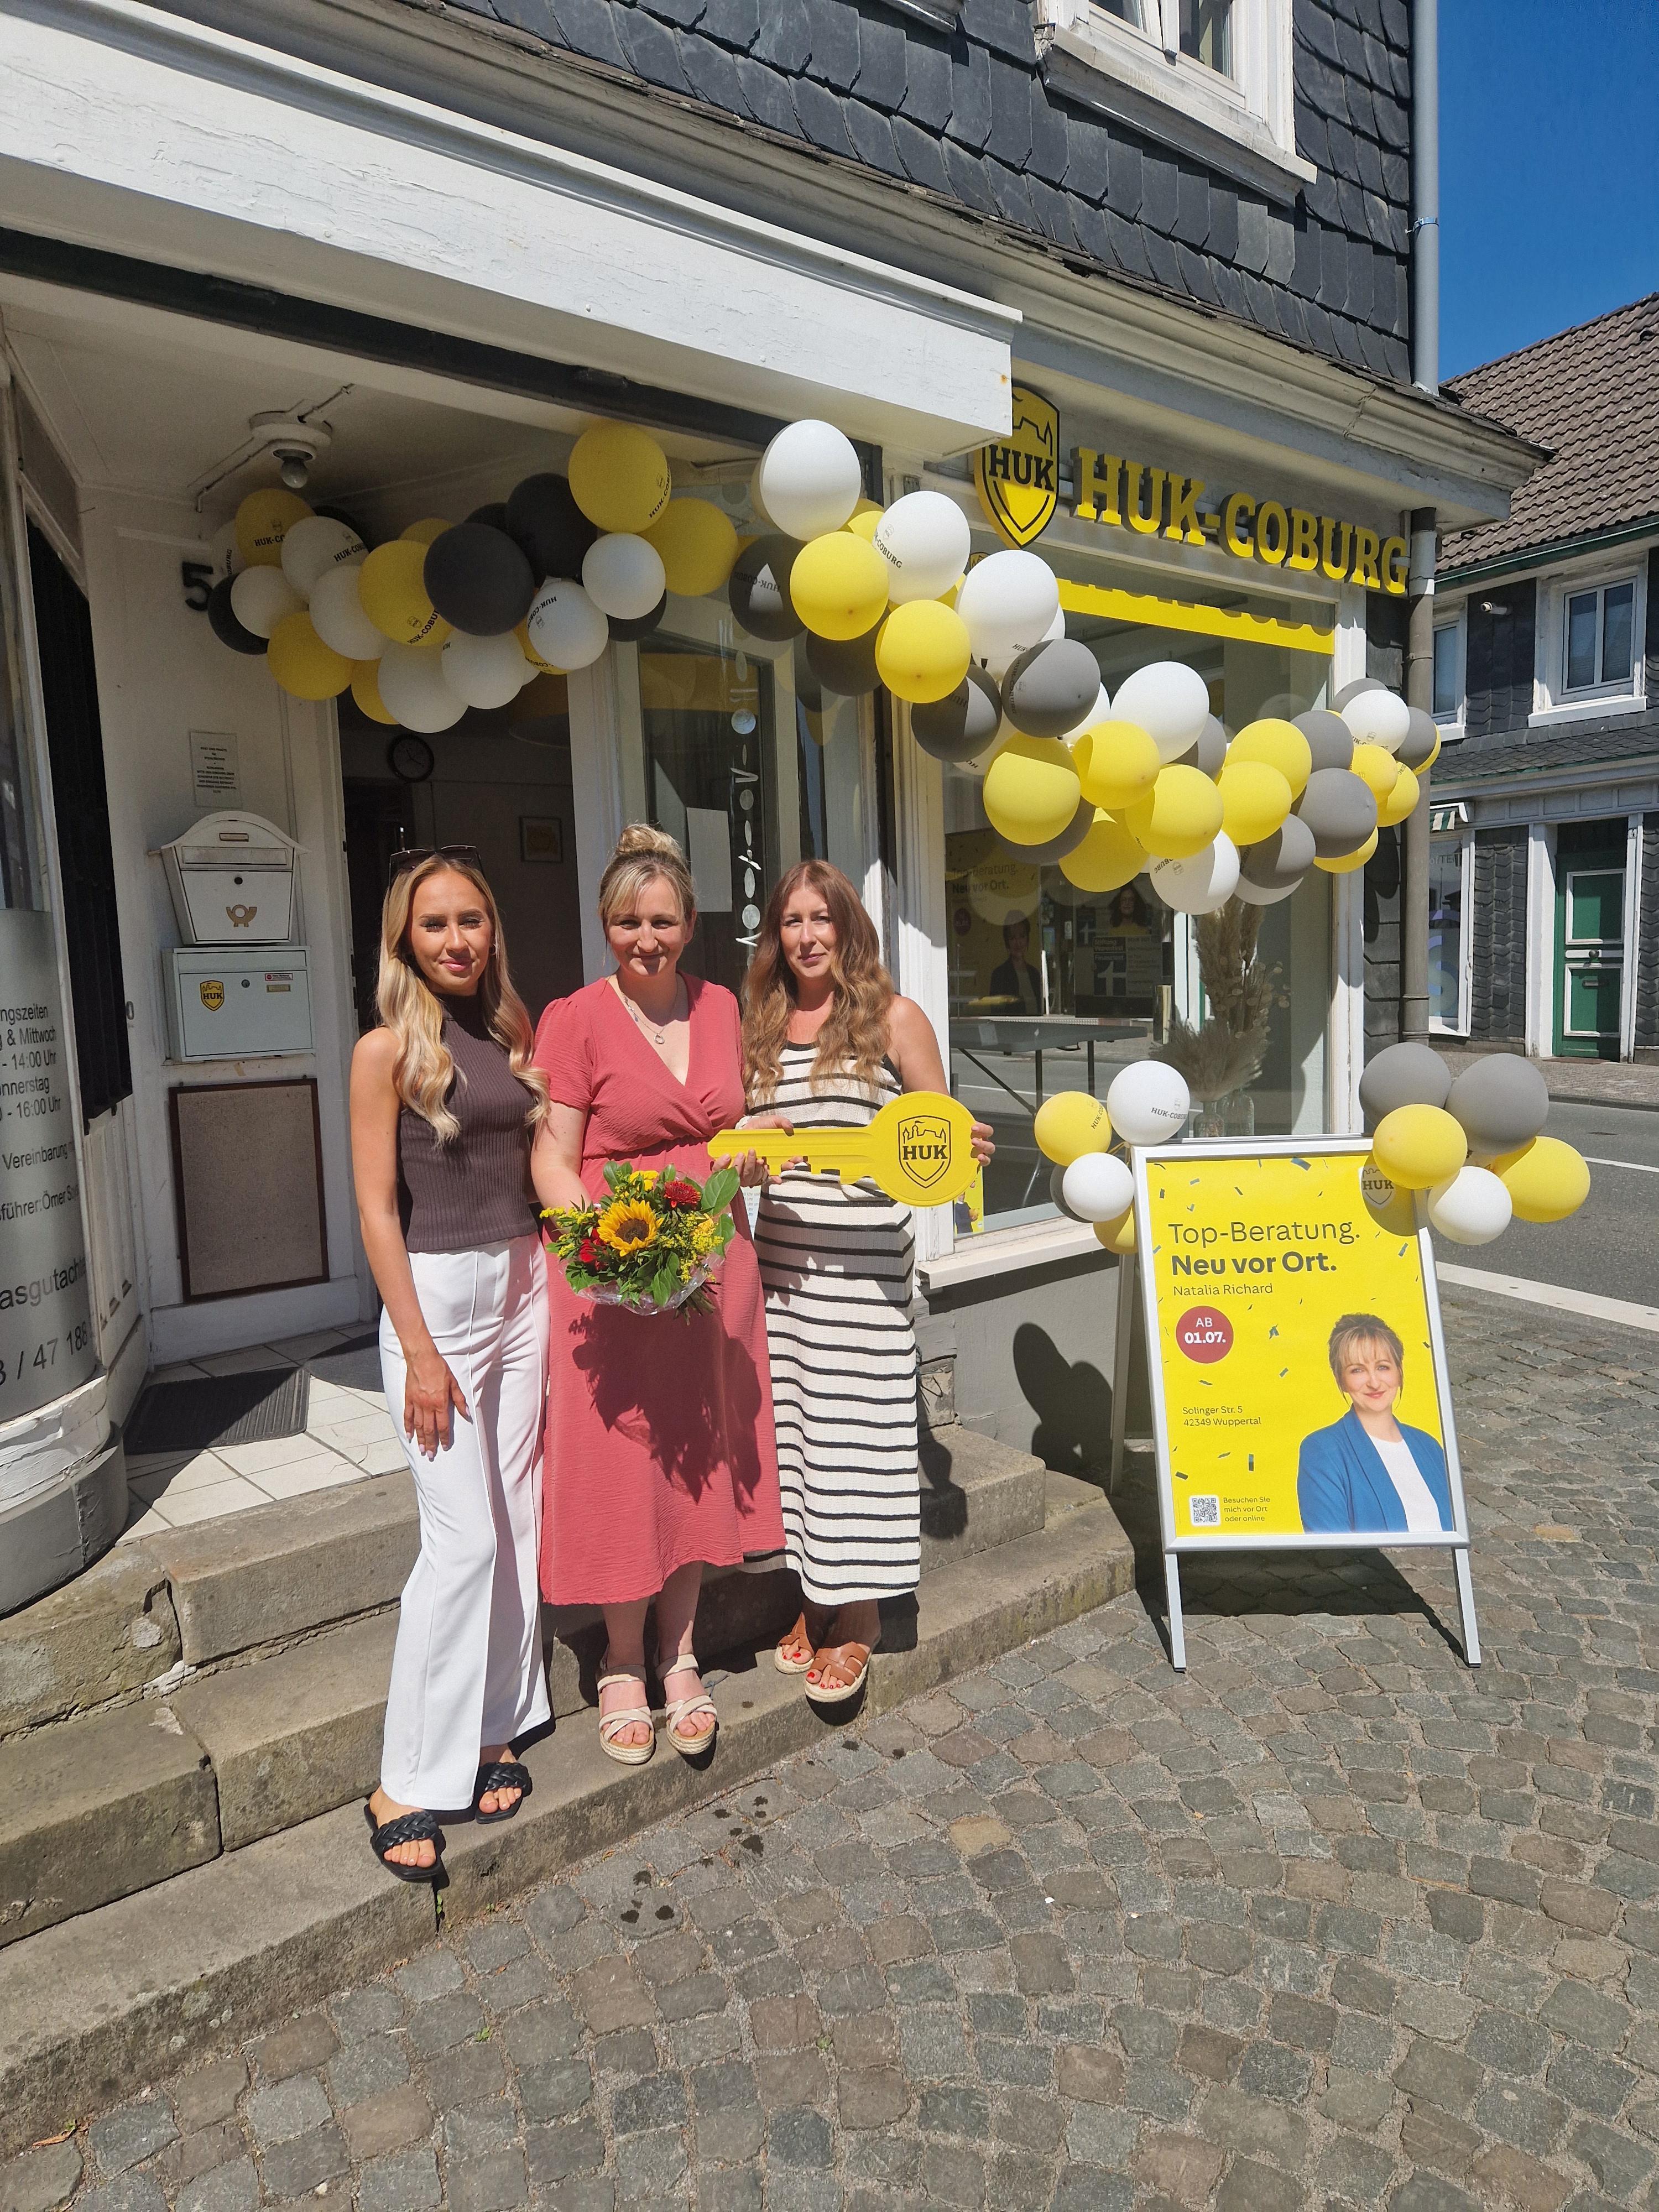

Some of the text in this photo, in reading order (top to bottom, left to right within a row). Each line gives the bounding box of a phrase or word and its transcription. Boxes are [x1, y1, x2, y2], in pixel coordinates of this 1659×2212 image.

[989, 444, 1054, 492] HUK
[1071, 446, 1408, 594] HUK-COBURG
[182, 561, 213, 612] 5
[7, 1029, 16, 1046] &
[19, 1025, 56, 1045] Mittwoch
[12, 1051, 41, 1070] 14:00
[44, 1050, 56, 1066] Uhr
[17, 1098, 46, 1118] 16:00
[49, 1095, 61, 1113] Uhr
[2, 1142, 67, 1170] Vereinbarung
[902, 1145, 948, 1160] HUK
[1362, 1180, 1394, 1190] HUK
[1168, 1222, 1360, 1248] Top-Beratung.
[1172, 1251, 1337, 1275] Neu vor Ort.
[0, 1255, 86, 1310] asgutach
[1173, 1283, 1272, 1296] Natalia Richard
[1196, 1317, 1213, 1327] AB
[1185, 1331, 1226, 1344] 01.07.
[17, 1350, 24, 1380] /
[33, 1337, 58, 1369] 47
[1182, 1406, 1219, 1416] Solinger
[1183, 1416, 1261, 1427] 42349 Wuppertal
